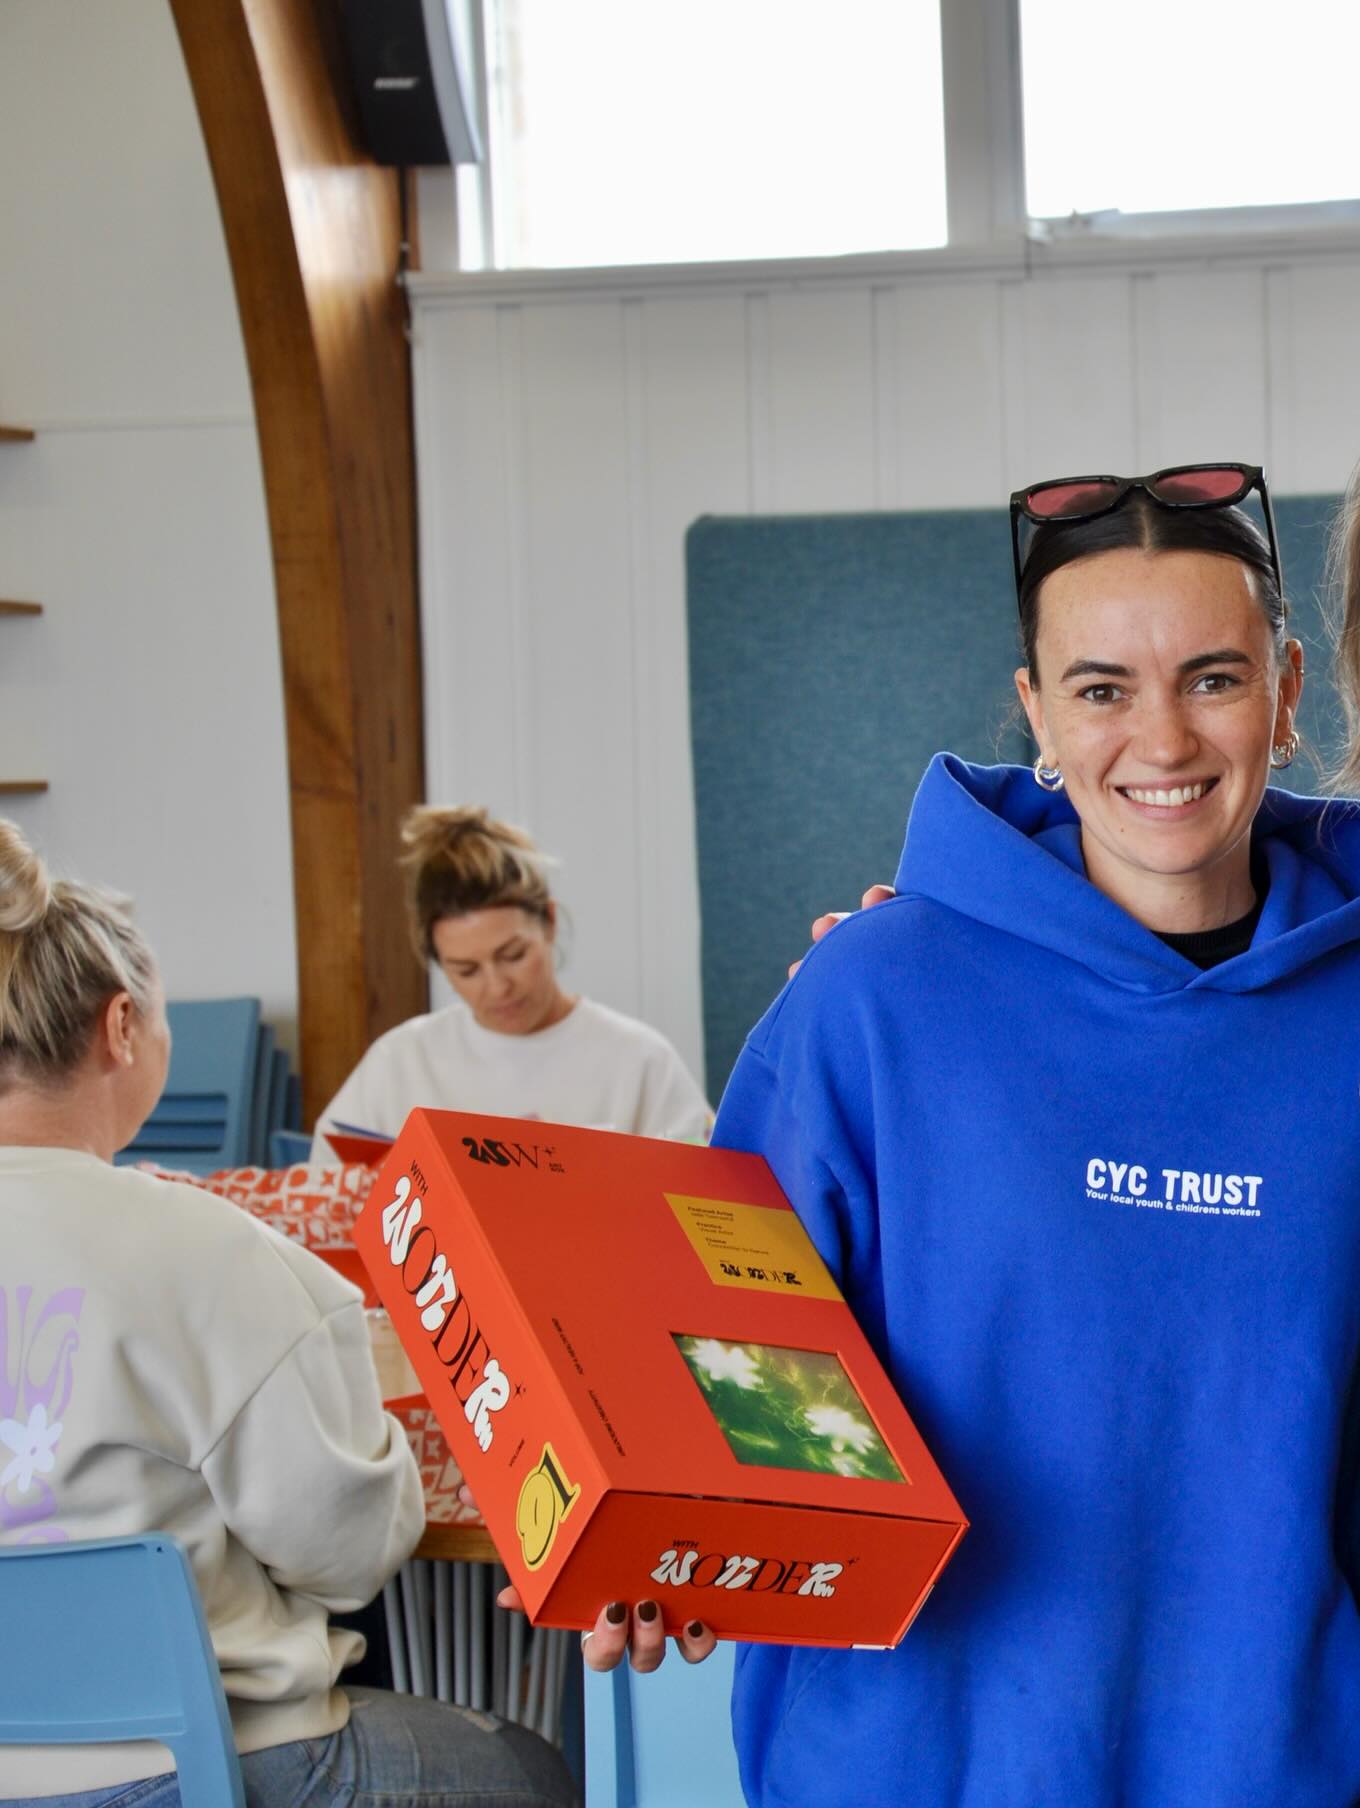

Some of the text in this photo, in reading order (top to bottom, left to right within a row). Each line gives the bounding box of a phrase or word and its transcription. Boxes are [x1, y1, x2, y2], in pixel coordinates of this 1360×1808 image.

[410, 1160, 429, 1196] WITH
[1086, 1158, 1263, 1207] CYC TRUST
[1086, 1188, 1261, 1218] Your local youth & childrens workers
[382, 1174, 511, 1454] WONDER
[673, 1541, 699, 1549] WITH
[650, 1549, 844, 1598] WONDER
